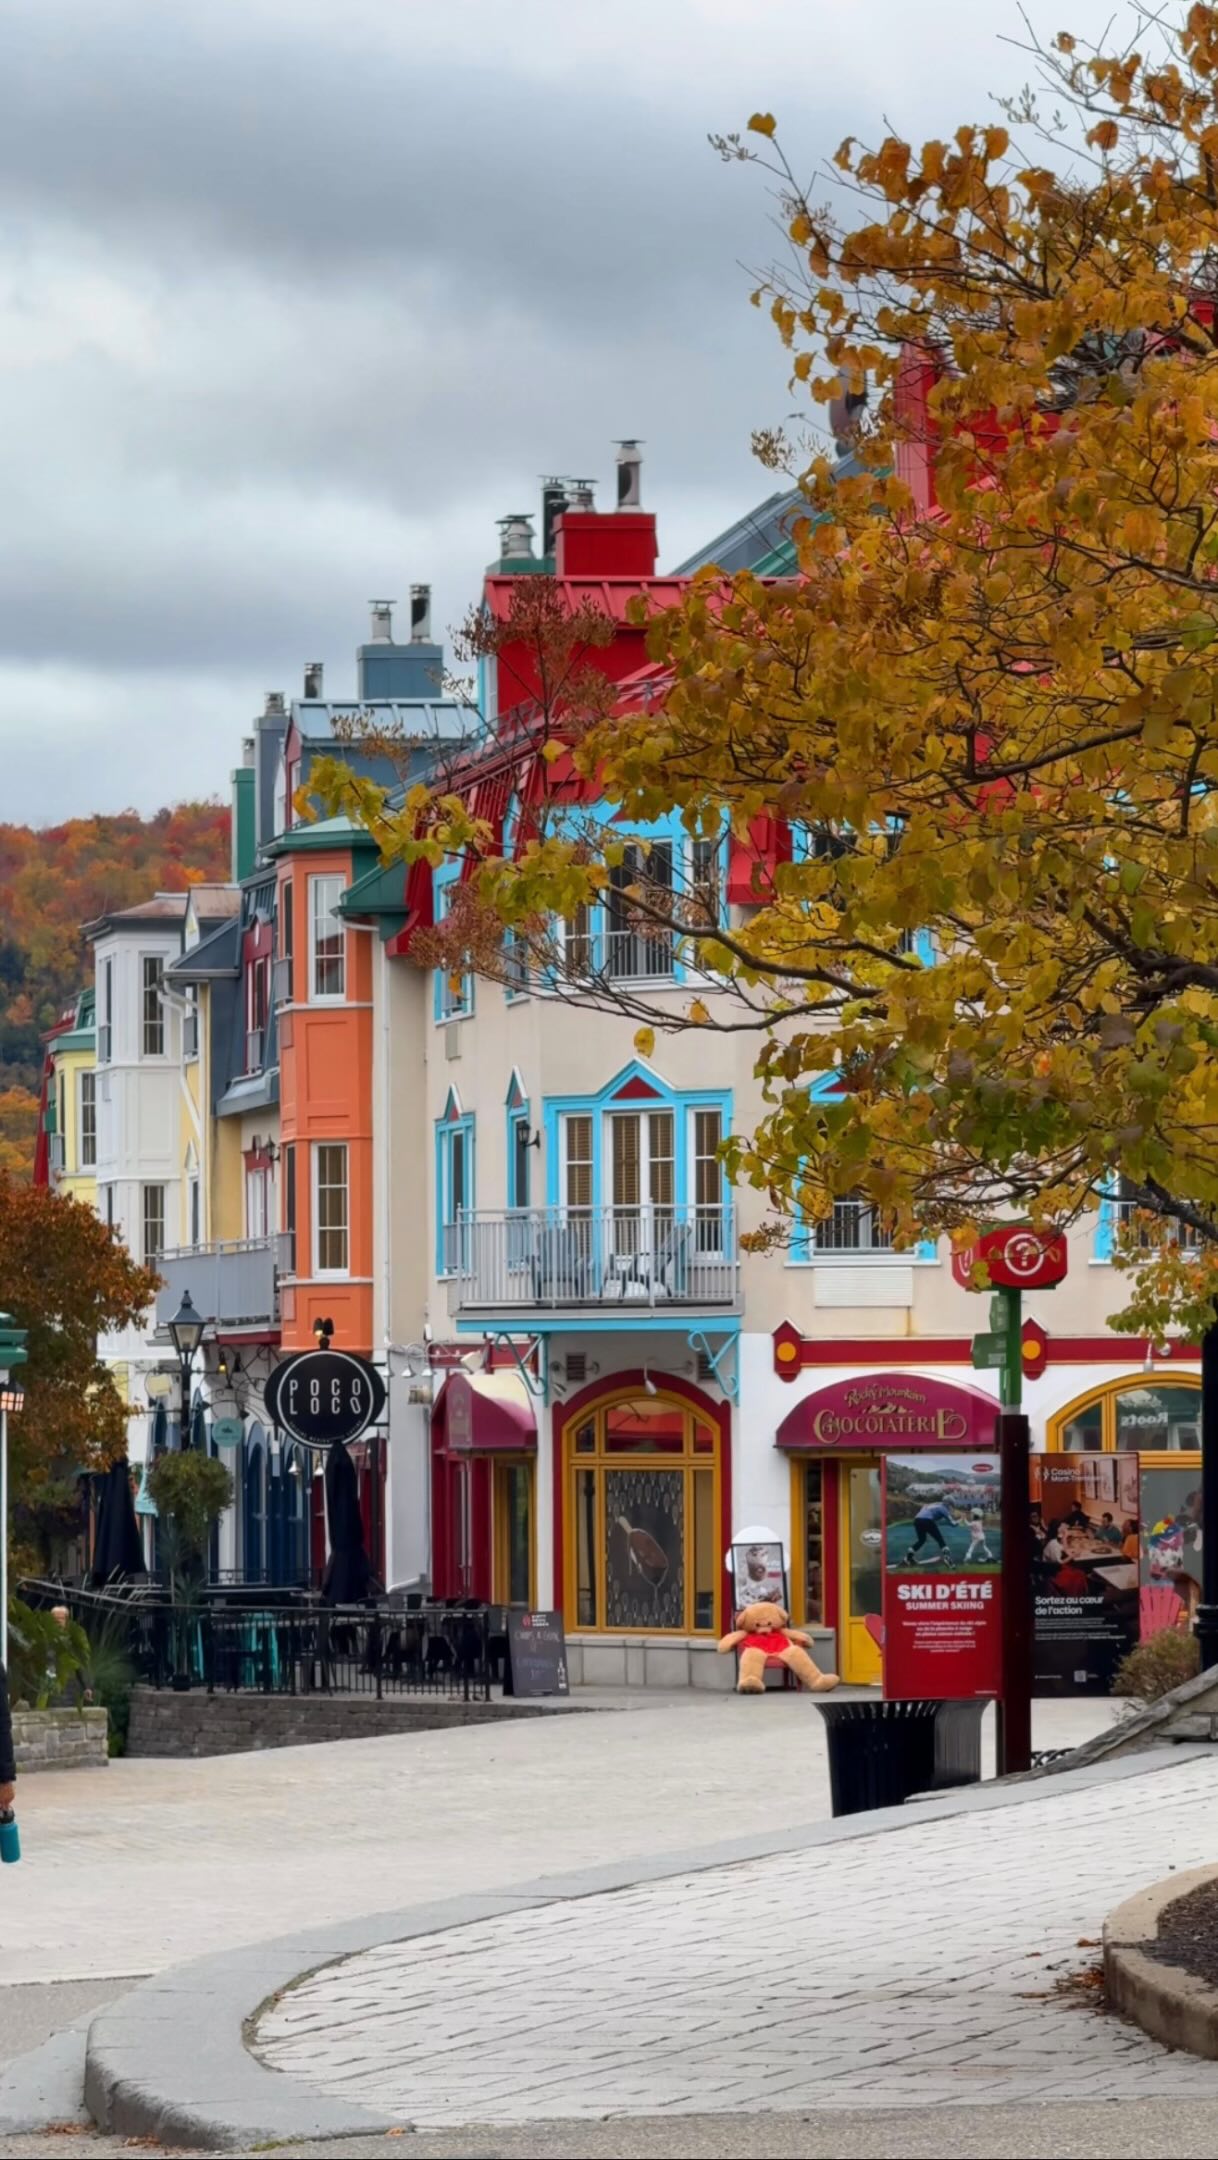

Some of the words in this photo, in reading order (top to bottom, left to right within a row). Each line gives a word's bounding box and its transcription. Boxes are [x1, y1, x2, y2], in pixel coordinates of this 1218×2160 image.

[289, 1378, 361, 1397] POCO
[844, 1383, 878, 1407] Rocky
[878, 1385, 926, 1405] Mountain
[289, 1396, 361, 1415] LOCO
[1050, 1467, 1081, 1476] Casino
[897, 1584, 932, 1600] SKI
[935, 1580, 993, 1600] D'ÉTÉ
[905, 1601, 948, 1611] SUMMER
[950, 1601, 984, 1610] SKIING
[1034, 1596, 1065, 1605] Sortez
[1079, 1596, 1104, 1604] cœur
[1034, 1606, 1048, 1615] de
[1048, 1605, 1083, 1615] l'action
